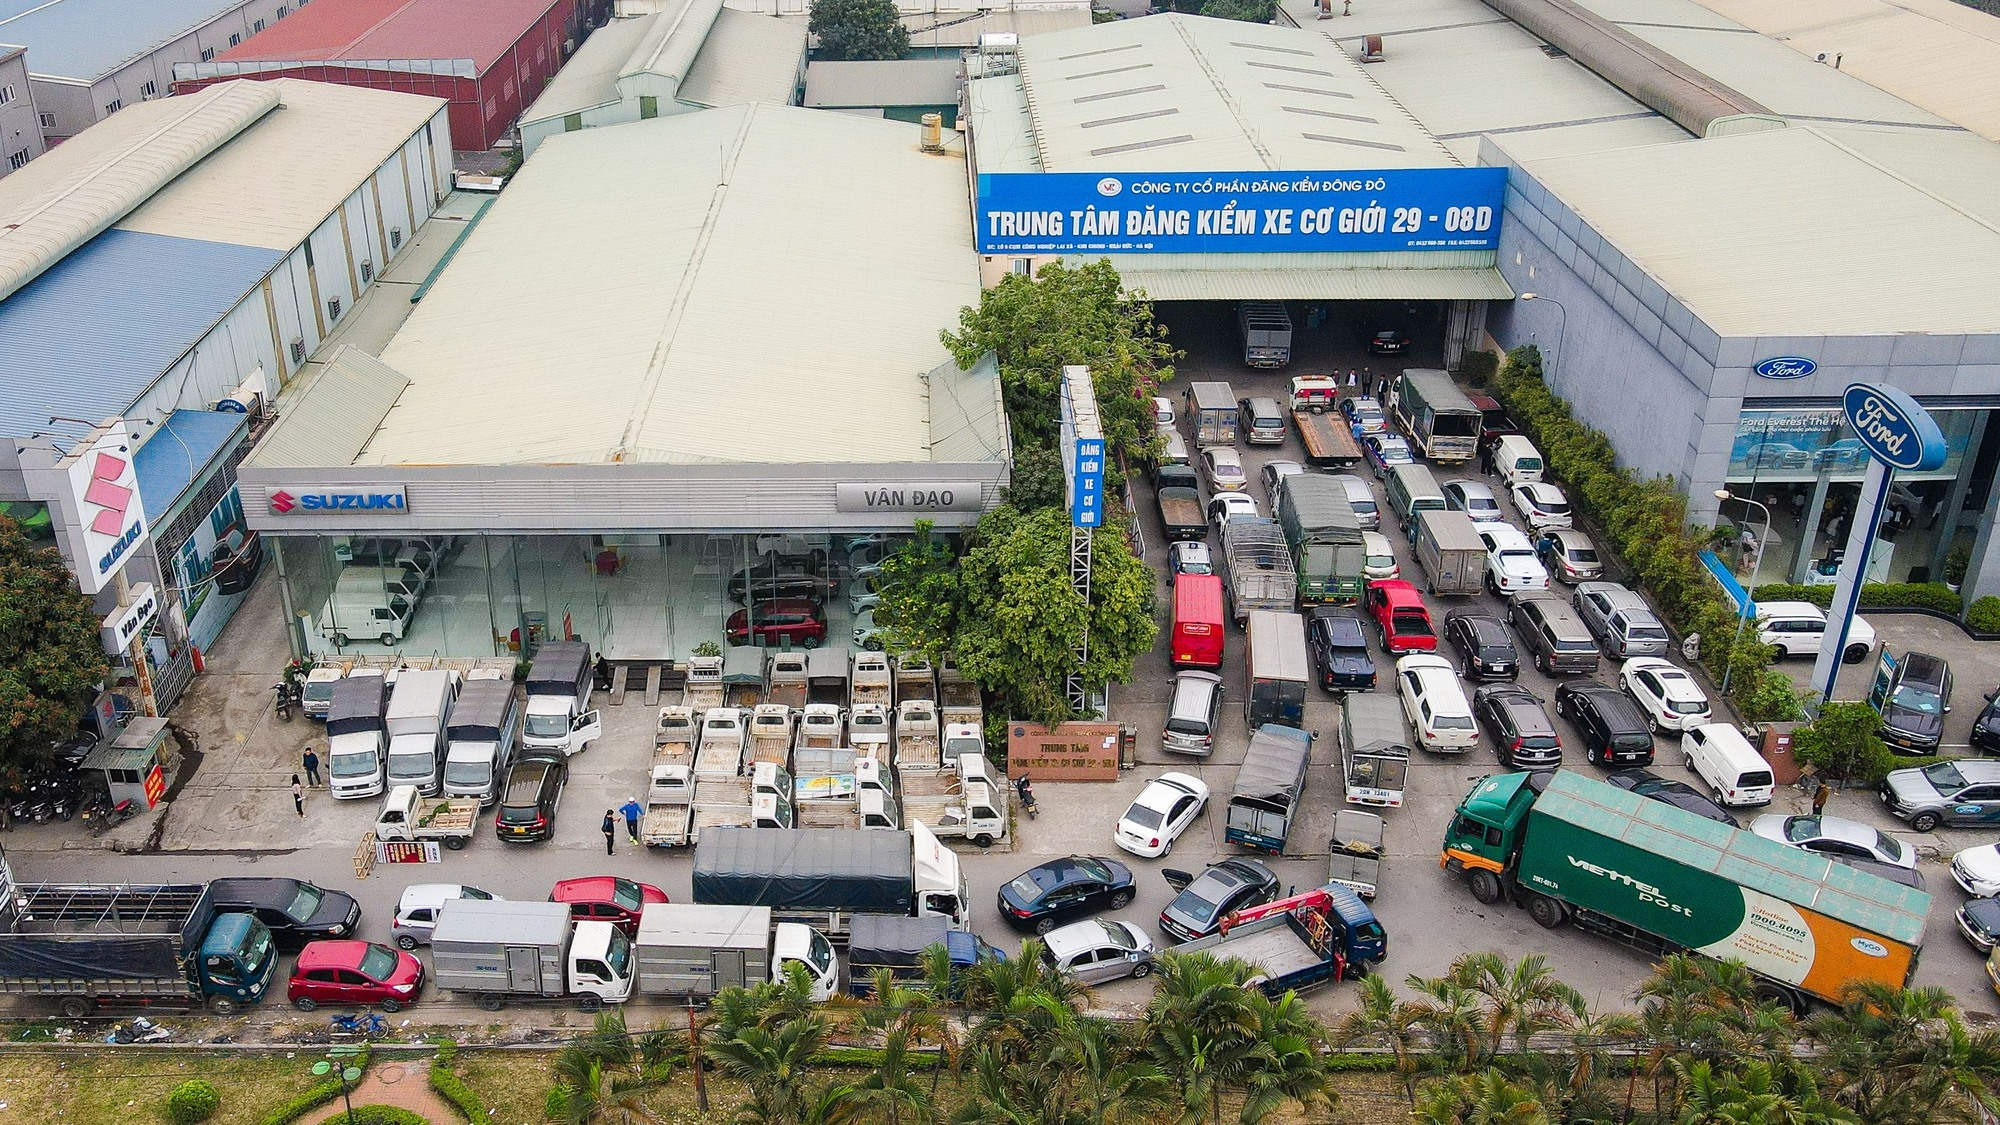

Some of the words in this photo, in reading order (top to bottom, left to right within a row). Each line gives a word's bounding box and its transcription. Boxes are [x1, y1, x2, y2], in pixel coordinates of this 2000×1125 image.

[1131, 179, 1172, 194] CÔNG
[1174, 182, 1190, 193] TY
[1191, 176, 1213, 193] CỔ
[1215, 177, 1250, 193] PHẦN
[1250, 179, 1290, 193] ĐĂNG
[1291, 175, 1320, 192] KIỂM
[1322, 178, 1363, 192] ĐÔNG
[1365, 177, 1386, 192] ĐÔ
[987, 211, 1064, 236] TRUNG
[1070, 204, 1120, 236] TÂM
[1126, 204, 1191, 236] ĐĂNG
[1196, 199, 1257, 235] KIỂM
[1262, 209, 1294, 235] XE
[1300, 206, 1335, 234] CƠ
[1338, 200, 1387, 234] GIỚI
[1391, 207, 1422, 233] 29
[1444, 205, 1493, 233] 08D
[1767, 361, 1805, 376] Ford
[1740, 417, 1765, 426] Ford
[1767, 417, 1807, 426] Everest
[1854, 396, 1908, 457] Ford
[1081, 443, 1100, 456] ĐĂNG
[1081, 458, 1098, 473] KIỂM
[1084, 479, 1094, 490] XE
[301, 493, 404, 510] SUZUKI
[864, 487, 904, 506] VÂN
[912, 490, 955, 509] ĐẠO
[1083, 494, 1094, 506] CƠ
[1081, 509, 1094, 523] GIỚI
[99, 519, 142, 575] SUZUKI
[1040, 743, 1067, 752] TRUNG
[1567, 855, 1667, 899] VIETTEL
[1639, 892, 1693, 917] post
[1758, 909, 1789, 923] Hotline
[1751, 913, 1807, 937] 1900.8095
